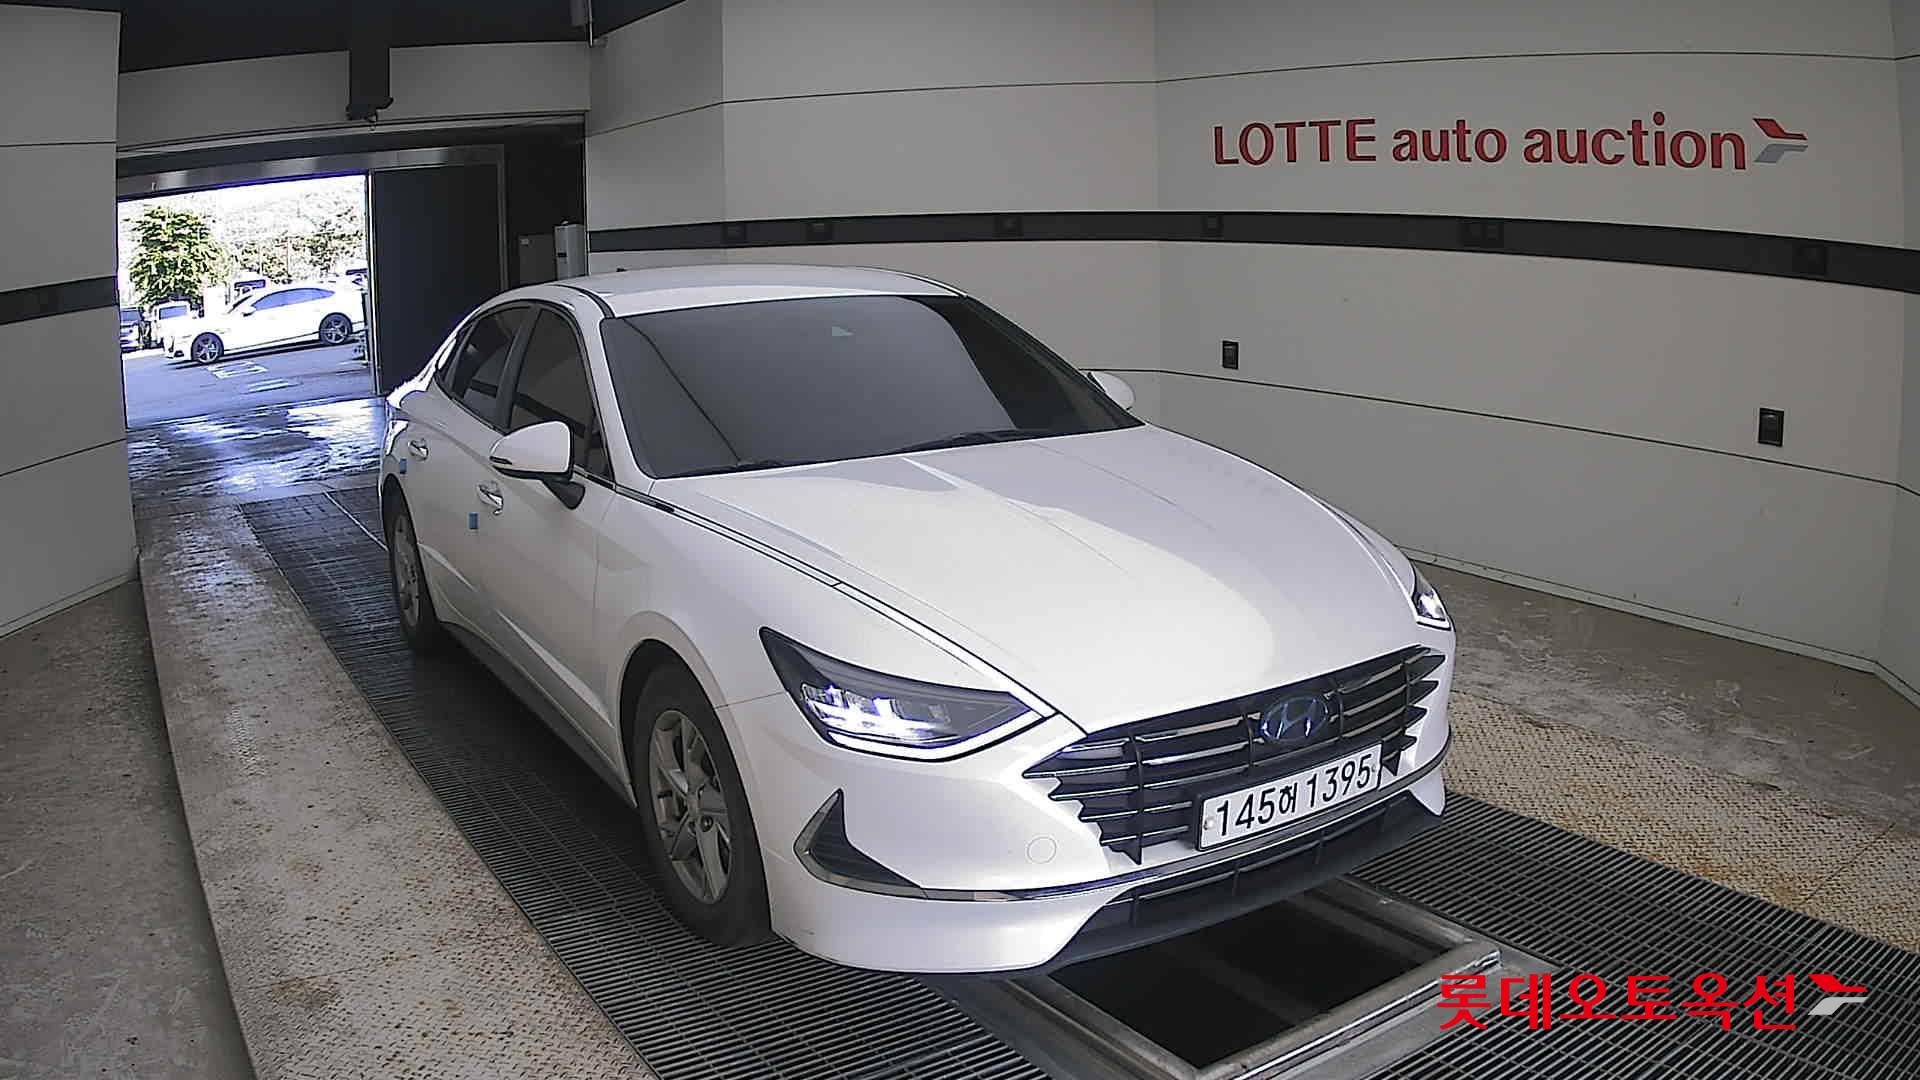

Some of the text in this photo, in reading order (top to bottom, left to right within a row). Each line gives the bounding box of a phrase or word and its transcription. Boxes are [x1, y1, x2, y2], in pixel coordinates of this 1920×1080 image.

[1213, 111, 1747, 170] LOTTE auto auction
[1216, 753, 1373, 837] 145허 1395
